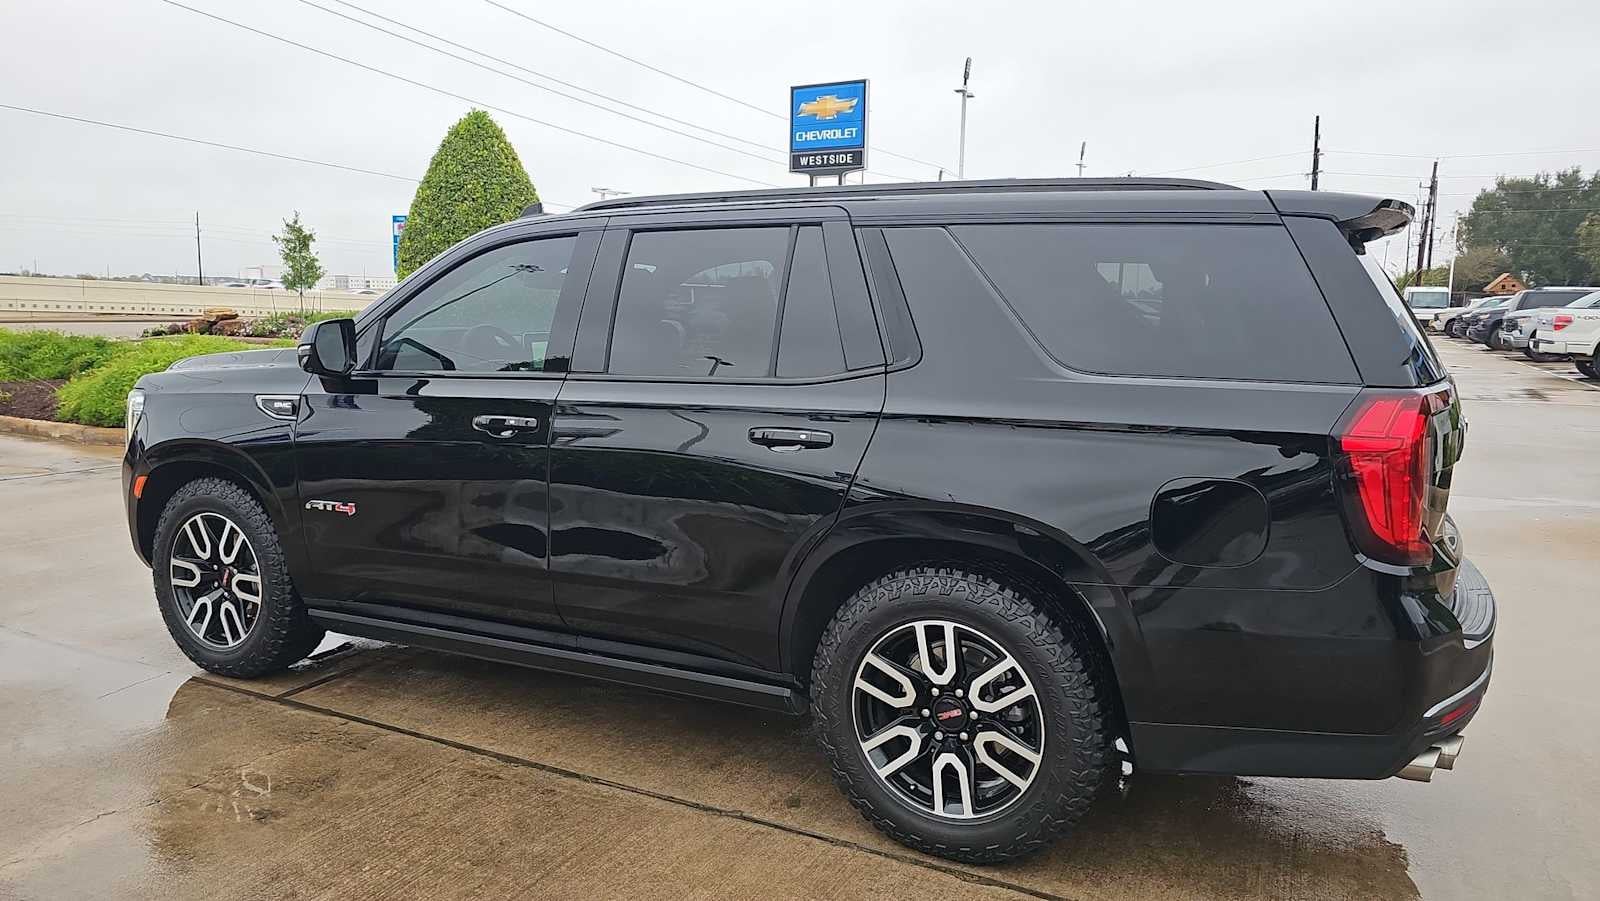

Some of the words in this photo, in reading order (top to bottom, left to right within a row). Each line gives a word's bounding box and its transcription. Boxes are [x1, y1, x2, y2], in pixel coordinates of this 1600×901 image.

[796, 127, 858, 142] CHEVROLET
[800, 153, 854, 166] WESTSIDE
[305, 500, 356, 516] AT4
